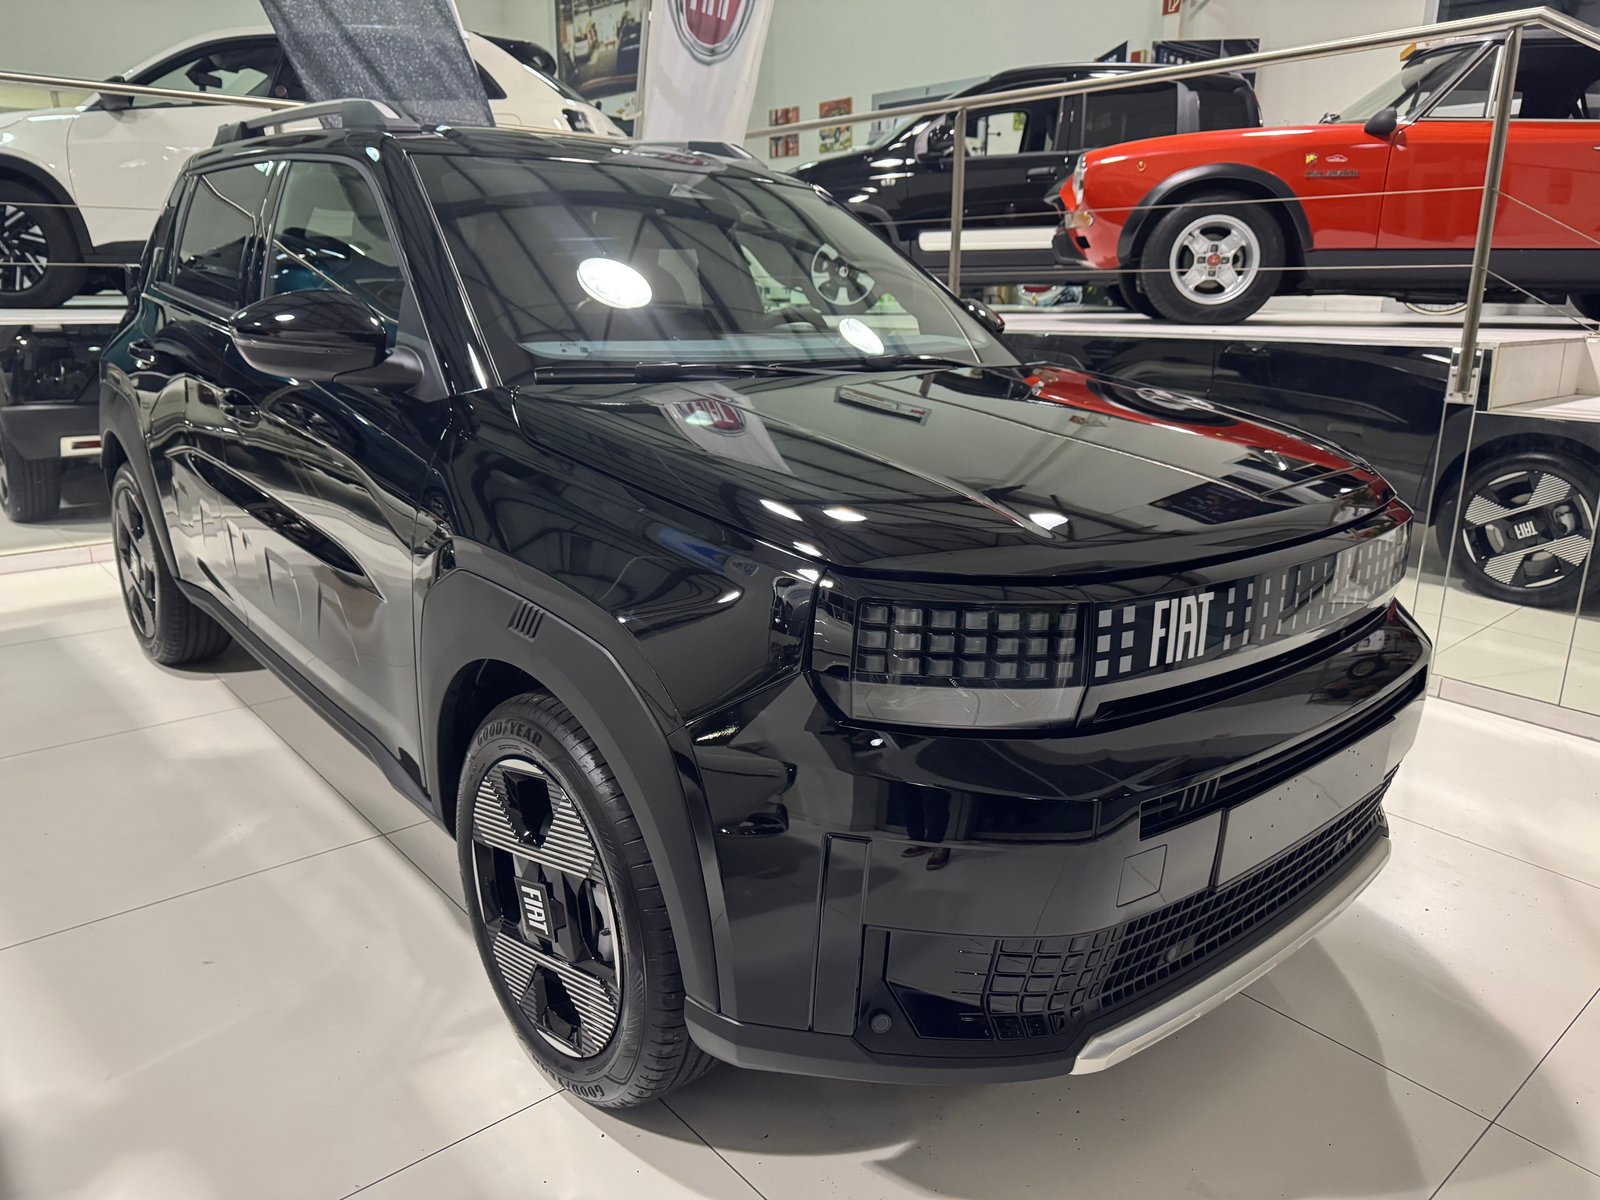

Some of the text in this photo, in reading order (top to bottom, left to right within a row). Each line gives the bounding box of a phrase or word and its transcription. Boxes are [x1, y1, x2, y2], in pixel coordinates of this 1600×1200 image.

[1149, 592, 1214, 667] FIAT
[477, 720, 543, 747] GOODYEAR
[521, 886, 549, 935] FIAT
